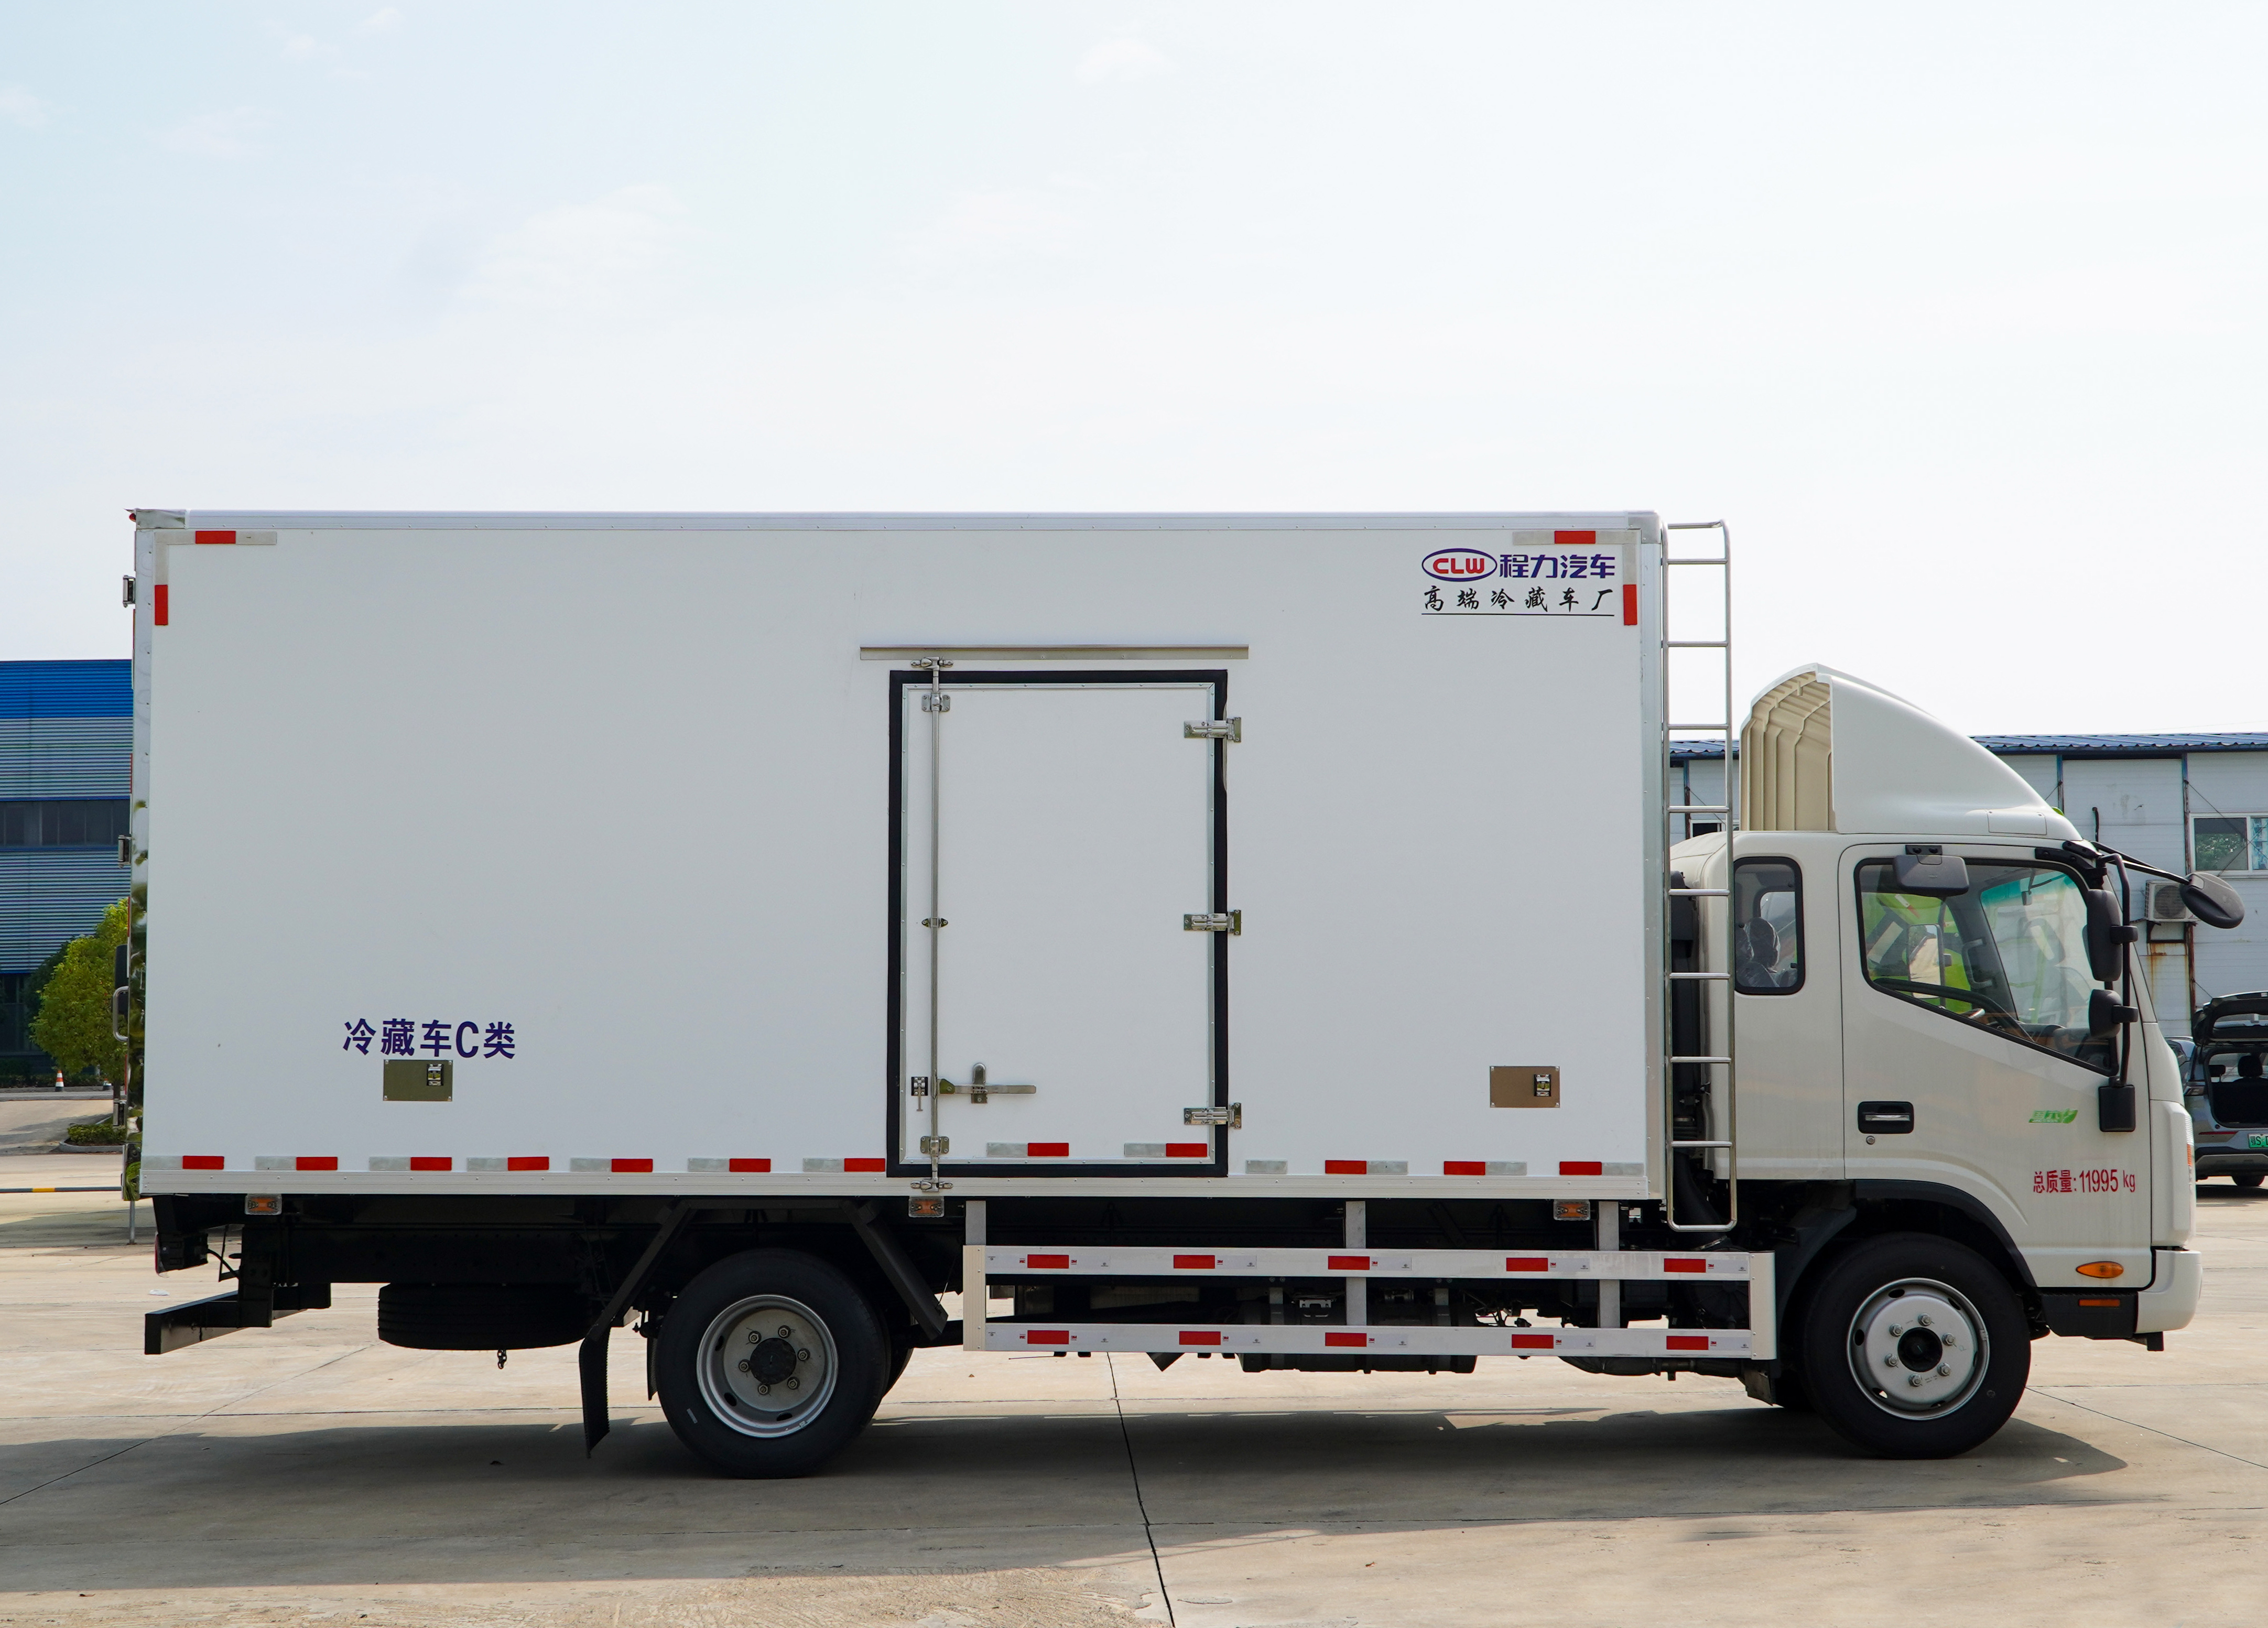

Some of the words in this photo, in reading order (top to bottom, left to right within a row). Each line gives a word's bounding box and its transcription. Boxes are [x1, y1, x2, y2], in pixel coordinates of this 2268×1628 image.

[1433, 558, 1485, 574] CLW
[1499, 553, 1615, 579] 程力汽车
[1424, 585, 1613, 612] 高端冷藏车厂
[343, 1018, 515, 1059] 冷藏车C类
[2123, 1170, 2136, 1193] kg
